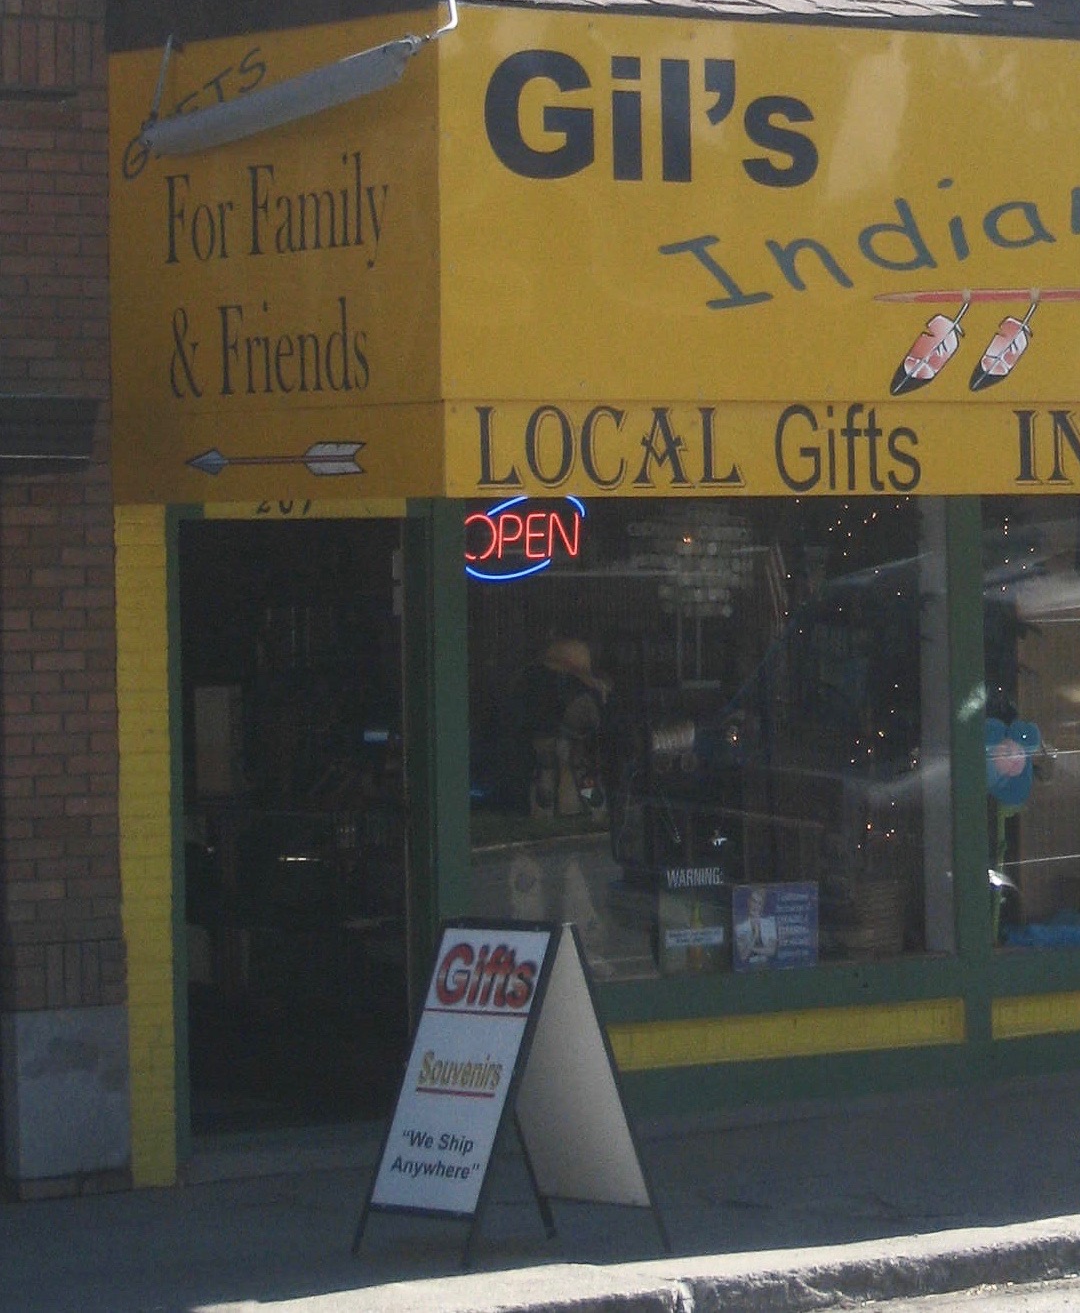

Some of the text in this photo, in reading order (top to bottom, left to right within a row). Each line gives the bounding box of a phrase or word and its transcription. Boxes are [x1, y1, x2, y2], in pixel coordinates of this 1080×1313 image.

[484, 49, 820, 188] Gil's
[164, 152, 388, 269] For Family
[168, 296, 371, 400] & Friends
[474, 404, 923, 494] LOCAL Gifts
[464, 513, 581, 561] OPEN
[435, 942, 537, 1009] Gifts
[417, 1049, 503, 1091] Souvenirs
[438, 1134, 474, 1155] Ship
